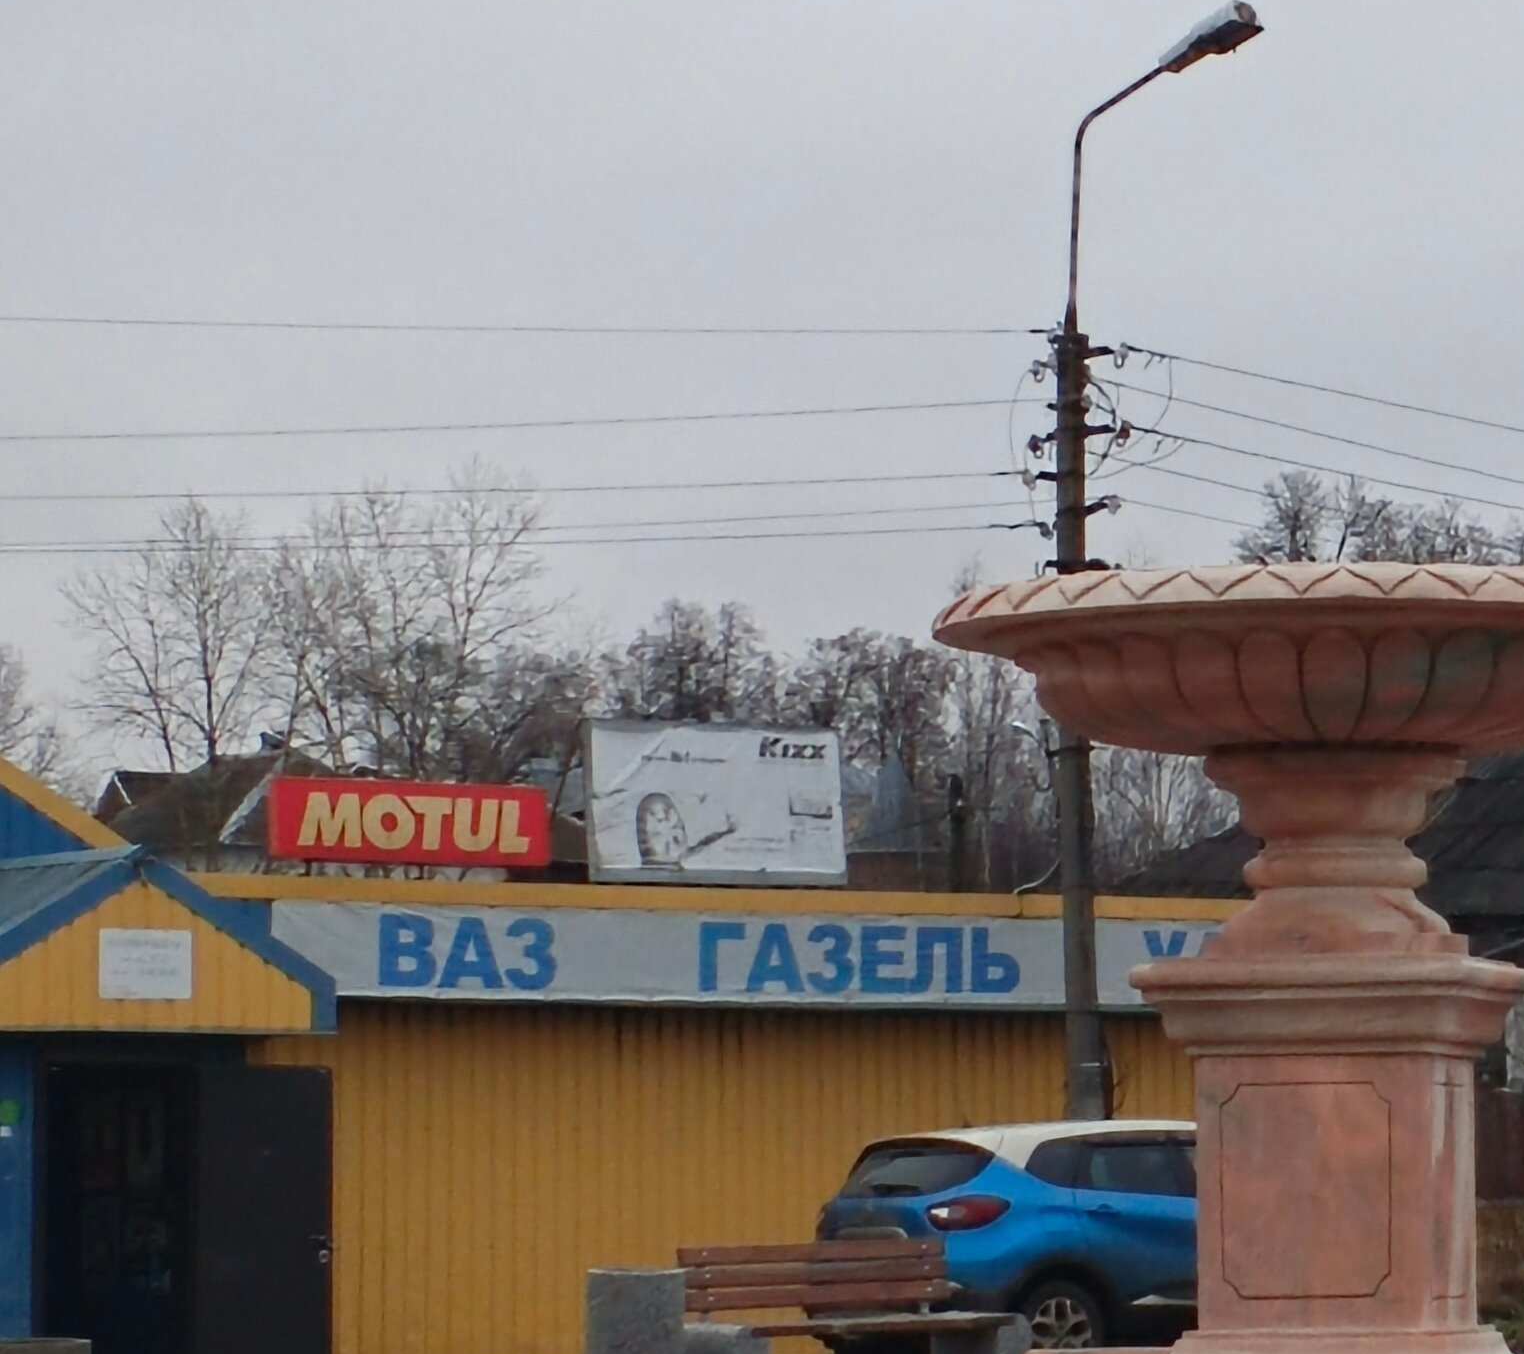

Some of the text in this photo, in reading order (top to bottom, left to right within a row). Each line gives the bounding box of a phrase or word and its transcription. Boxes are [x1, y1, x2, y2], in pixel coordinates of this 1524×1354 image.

[297, 791, 530, 854] MOTUL
[378, 912, 1021, 994] ВАЗ ГАЗЕЛЬ
